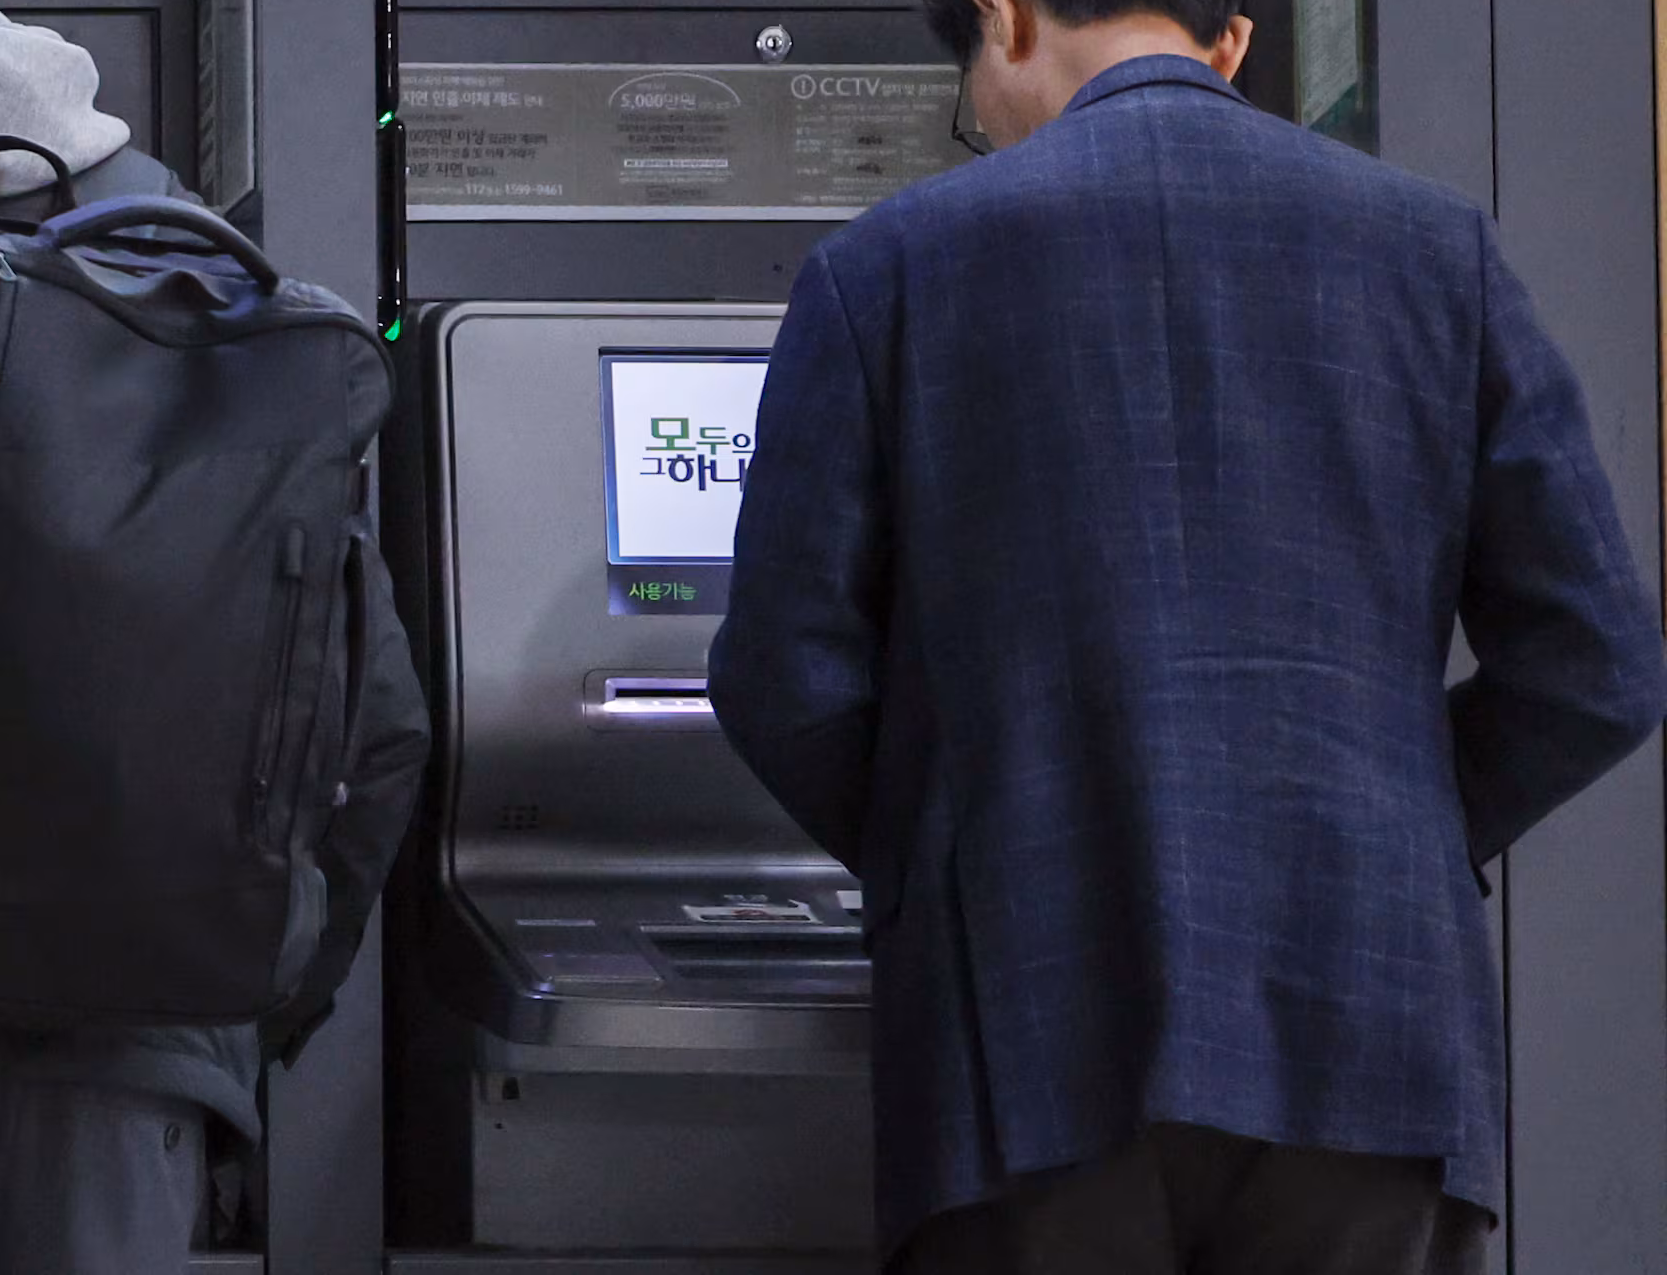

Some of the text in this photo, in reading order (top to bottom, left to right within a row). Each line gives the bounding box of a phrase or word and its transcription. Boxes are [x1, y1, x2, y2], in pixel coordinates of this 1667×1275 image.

[820, 77, 881, 96] CCTV
[408, 129, 453, 146] 00만원
[409, 163, 430, 177] 0분
[629, 582, 697, 601] 사용가능
